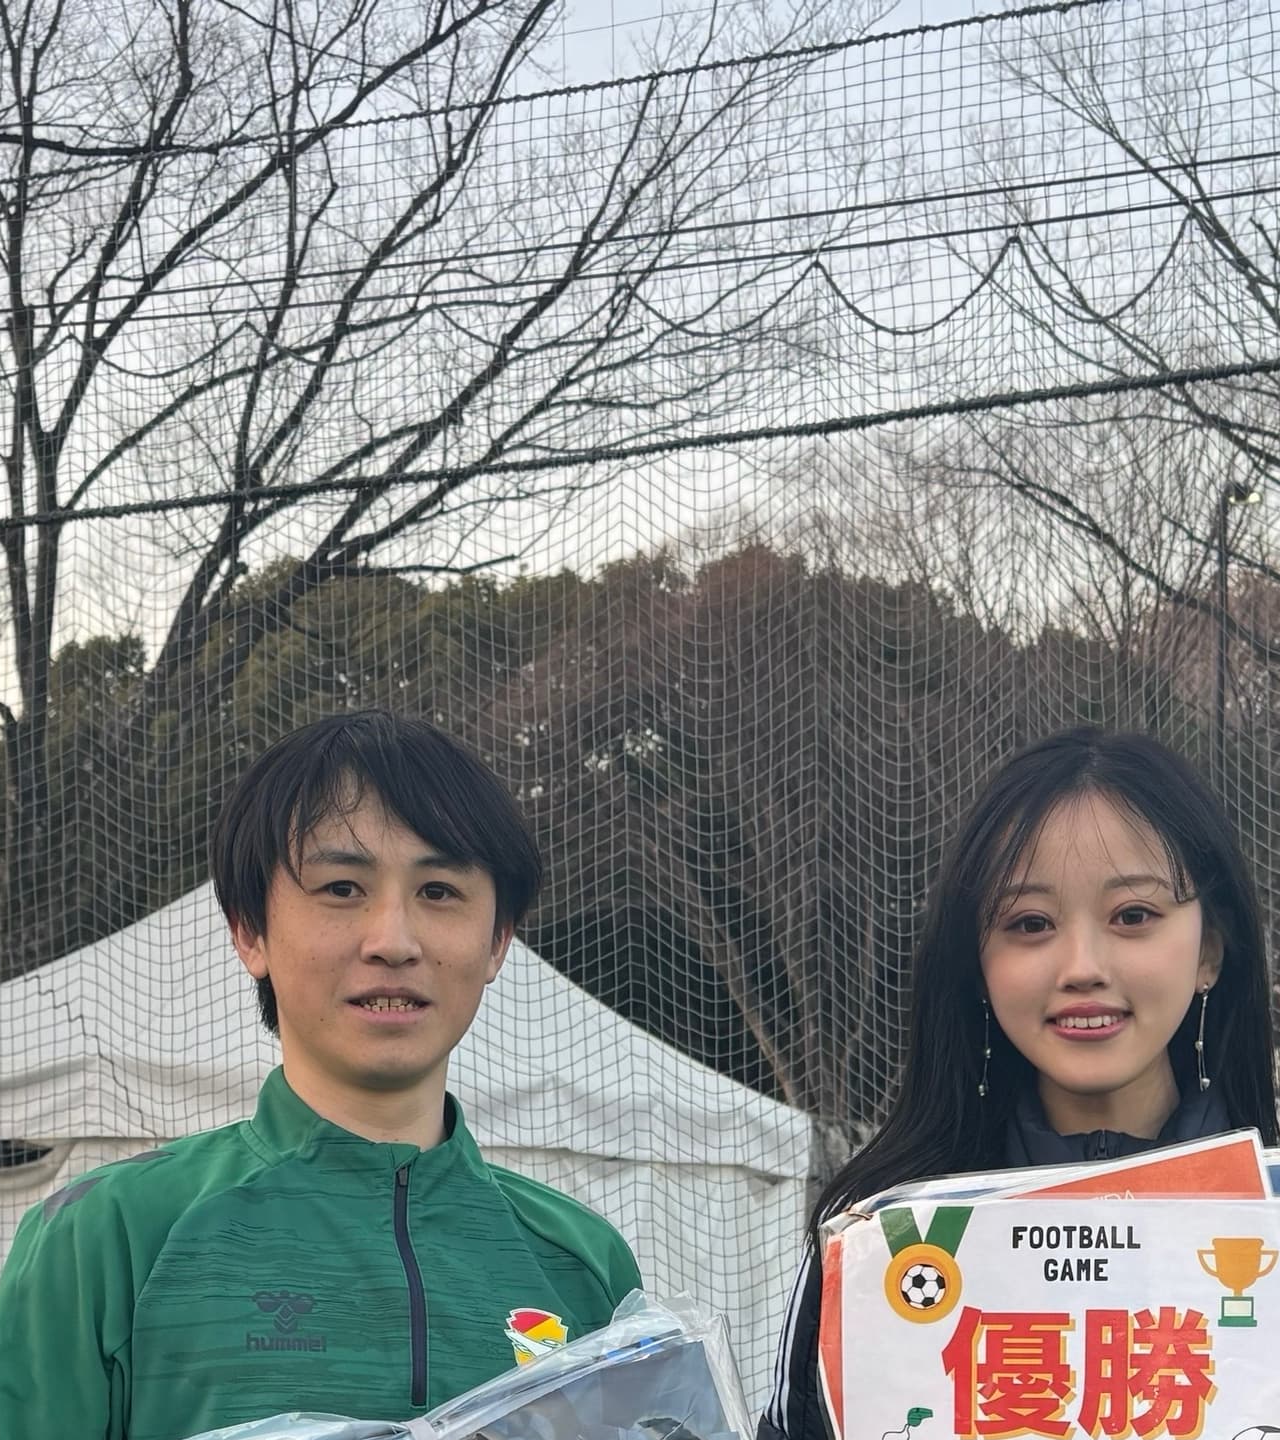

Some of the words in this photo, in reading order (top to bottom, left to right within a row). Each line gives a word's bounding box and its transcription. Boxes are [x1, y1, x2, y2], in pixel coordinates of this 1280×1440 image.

[1012, 1225, 1141, 1249] FOOTBALL
[1043, 1258, 1109, 1282] GAME
[246, 1332, 327, 1353] hummel
[941, 1306, 1216, 1440] 優勝
